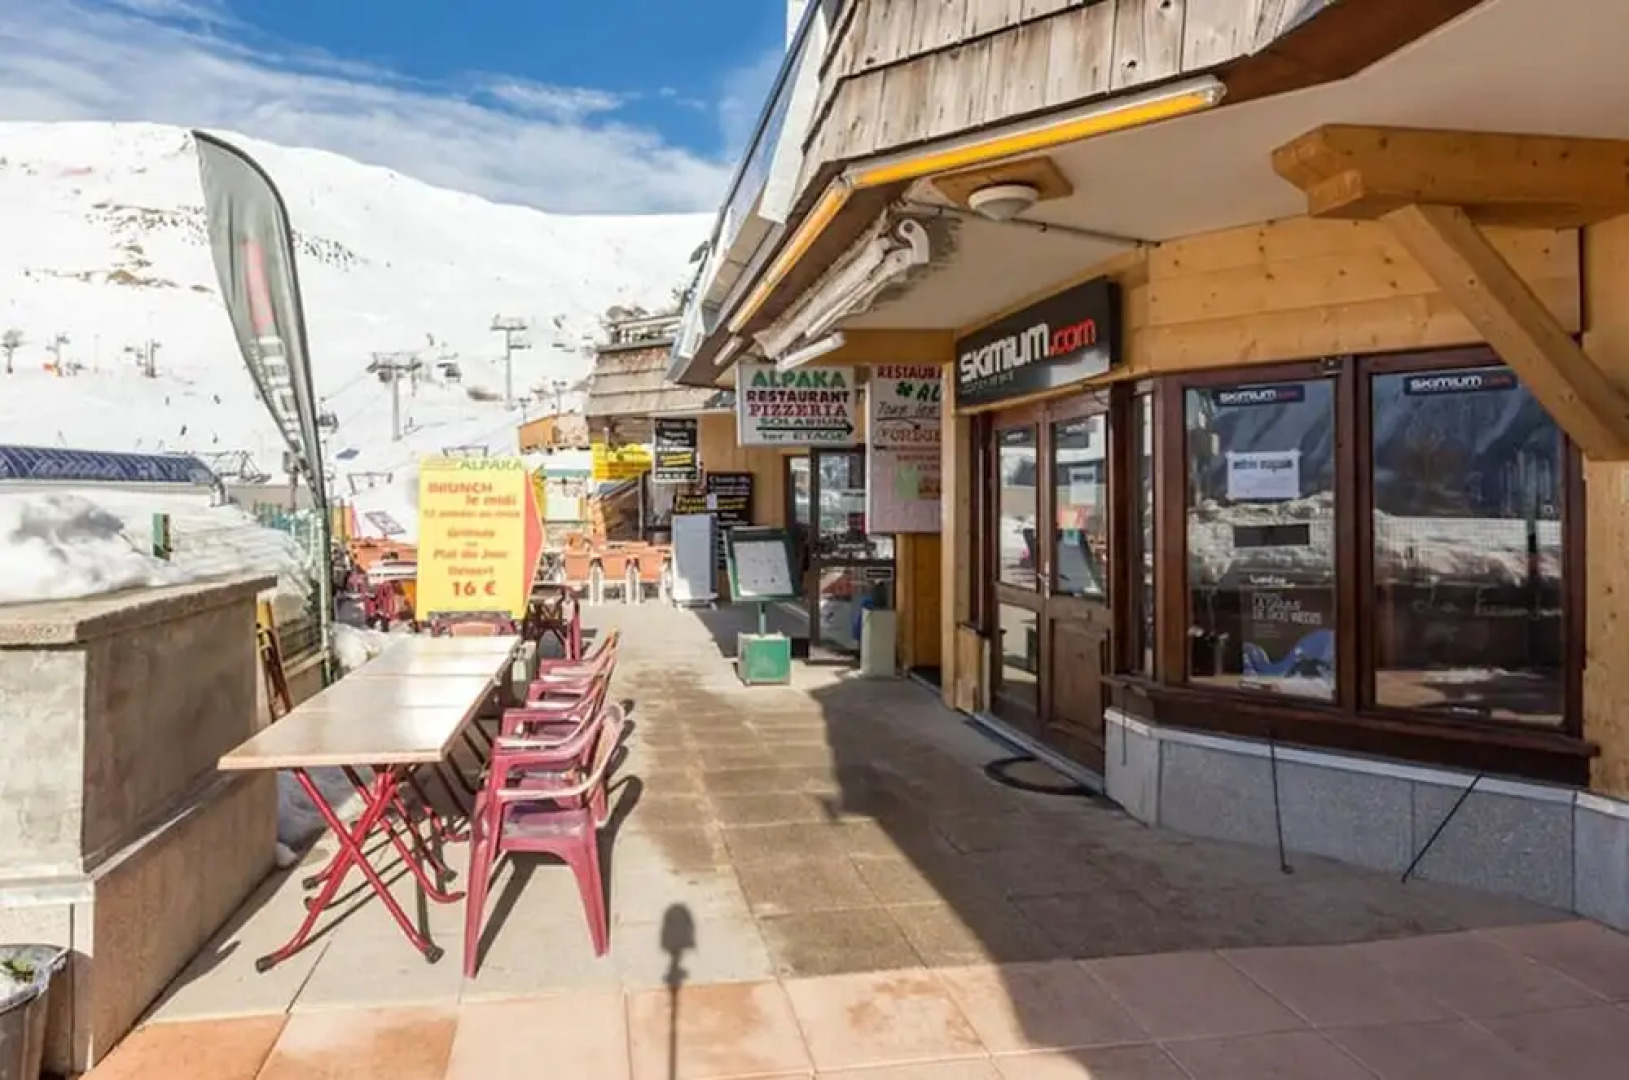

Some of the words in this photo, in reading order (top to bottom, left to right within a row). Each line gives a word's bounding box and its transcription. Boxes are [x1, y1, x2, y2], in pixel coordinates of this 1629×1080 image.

[751, 370, 847, 388] ALPAKA
[746, 390, 849, 403] RESTAURANT
[749, 403, 849, 417] PIZZERIA
[460, 460, 522, 470] ALPAKA
[428, 482, 493, 493] BRUNCH
[466, 495, 479, 505] le
[453, 582, 476, 596] 16
[484, 580, 496, 596] €
